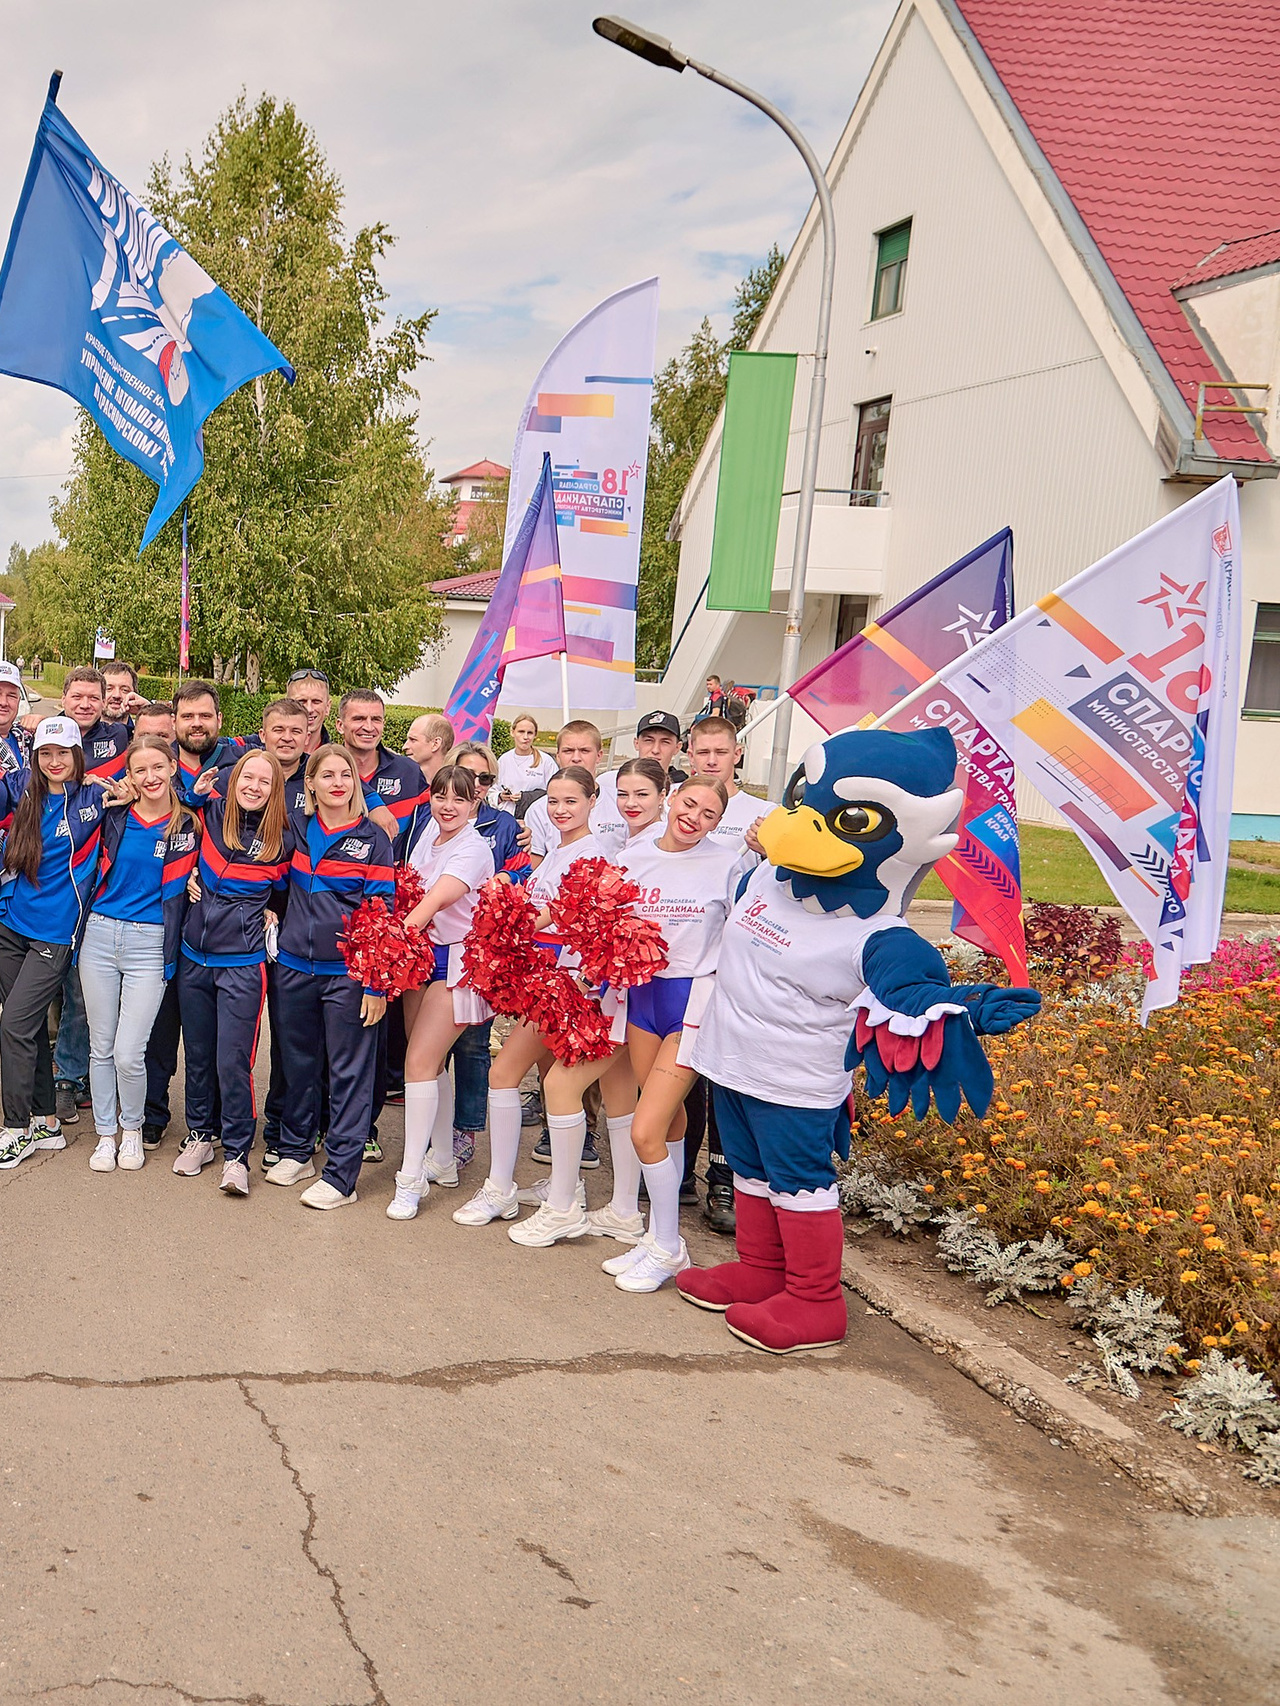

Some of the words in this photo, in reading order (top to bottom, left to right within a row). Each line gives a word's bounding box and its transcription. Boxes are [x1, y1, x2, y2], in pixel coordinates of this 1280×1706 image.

[1086, 698, 1185, 794] МИНИСТЕРСТВА
[983, 816, 1011, 843] КРАЯ
[637, 887, 661, 905] 18
[641, 905, 706, 914] СПАРТАКИАДА
[744, 900, 768, 918] 18
